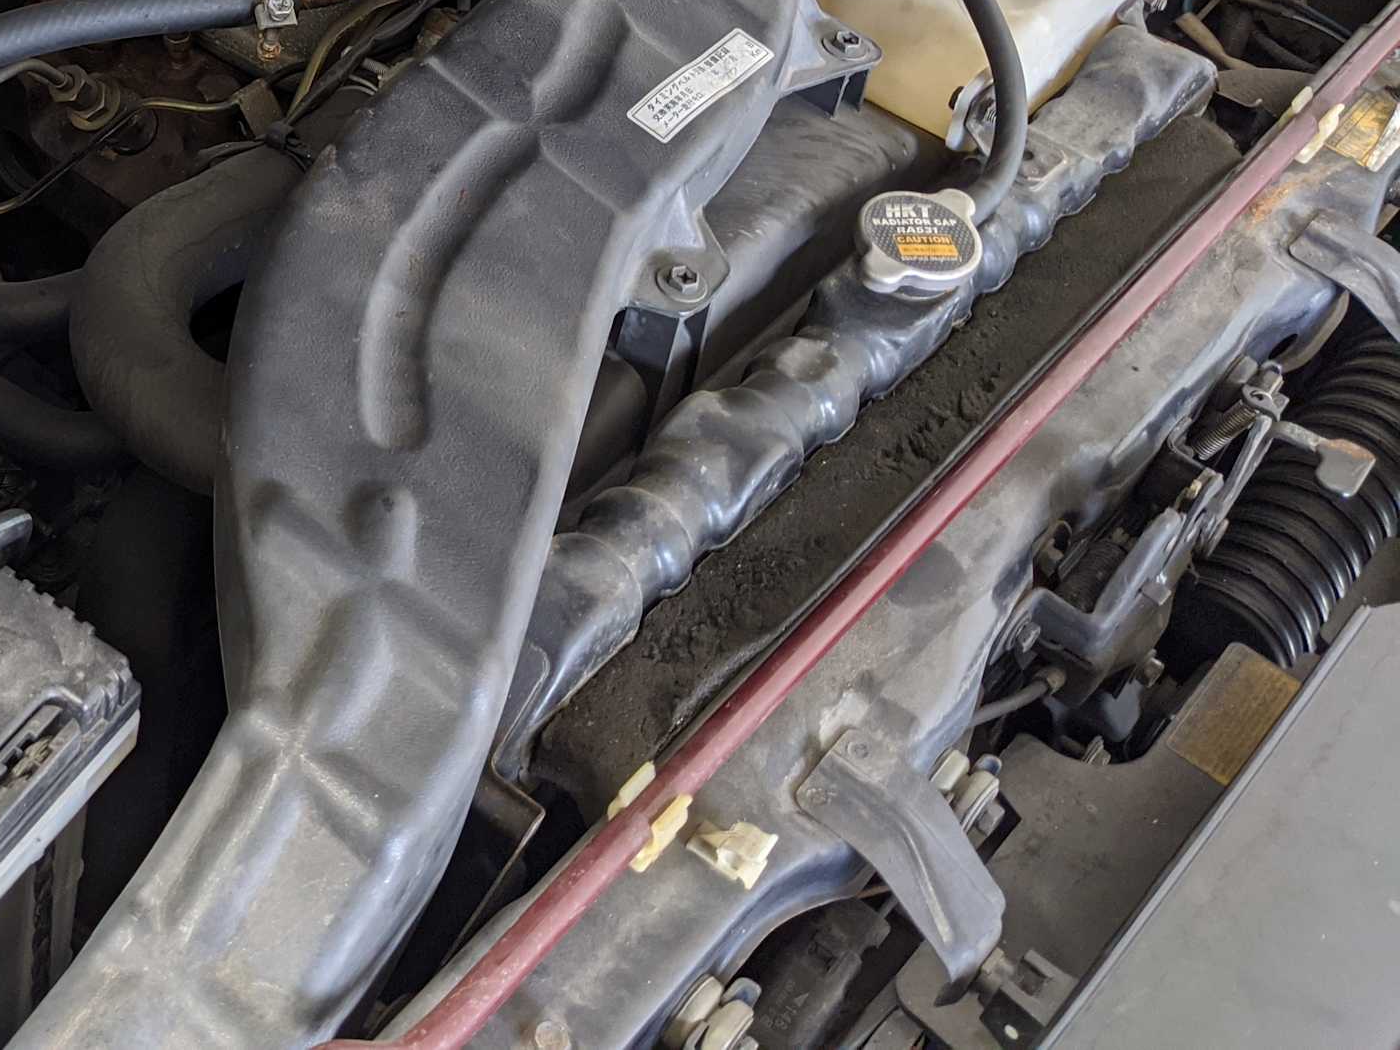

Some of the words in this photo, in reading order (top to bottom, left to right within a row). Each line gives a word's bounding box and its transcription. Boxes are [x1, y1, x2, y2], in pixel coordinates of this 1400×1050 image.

[885, 203, 931, 218] HKT
[872, 217, 931, 226] RADIATOR
[933, 218, 957, 226] CAP
[897, 236, 950, 244] CAUTION
